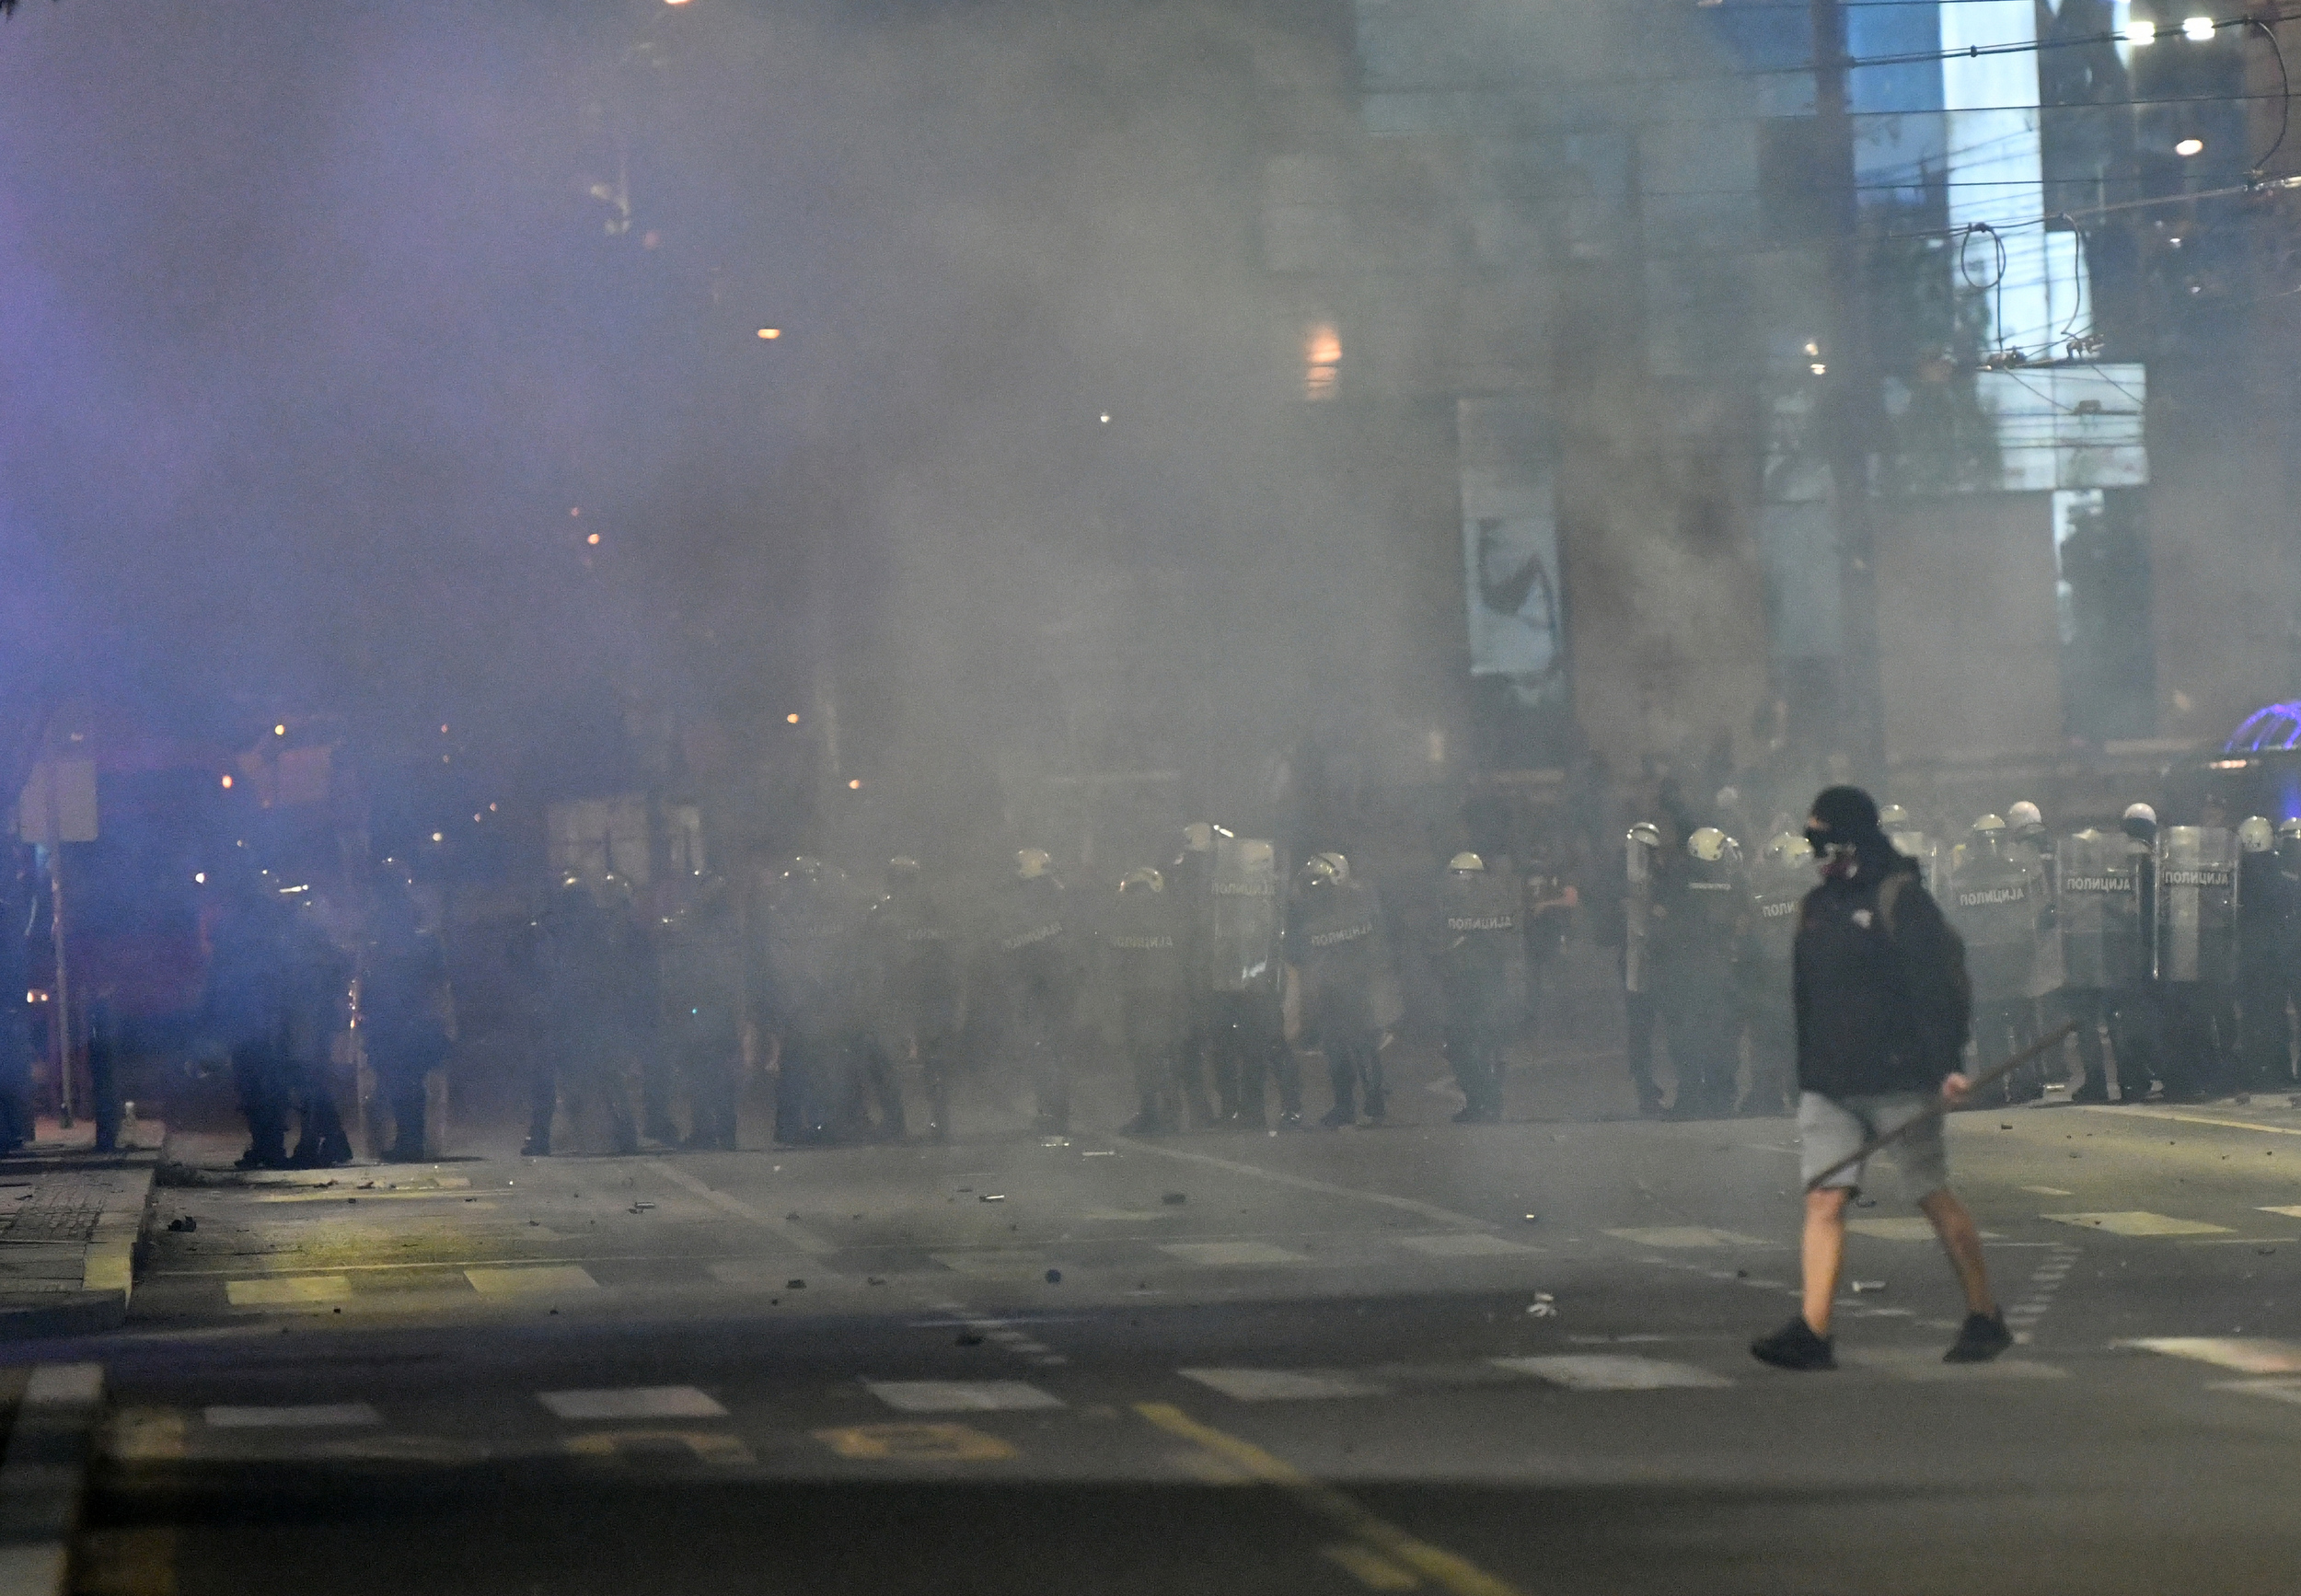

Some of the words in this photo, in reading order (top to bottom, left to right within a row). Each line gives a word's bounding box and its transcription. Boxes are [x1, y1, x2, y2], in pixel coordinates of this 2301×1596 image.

[2067, 877, 2131, 892] ПОЛИЦИЈА
[2165, 871, 2228, 886] ПОЛИЦИЈА
[1960, 888, 2024, 907] ПОЛИЦИЈА
